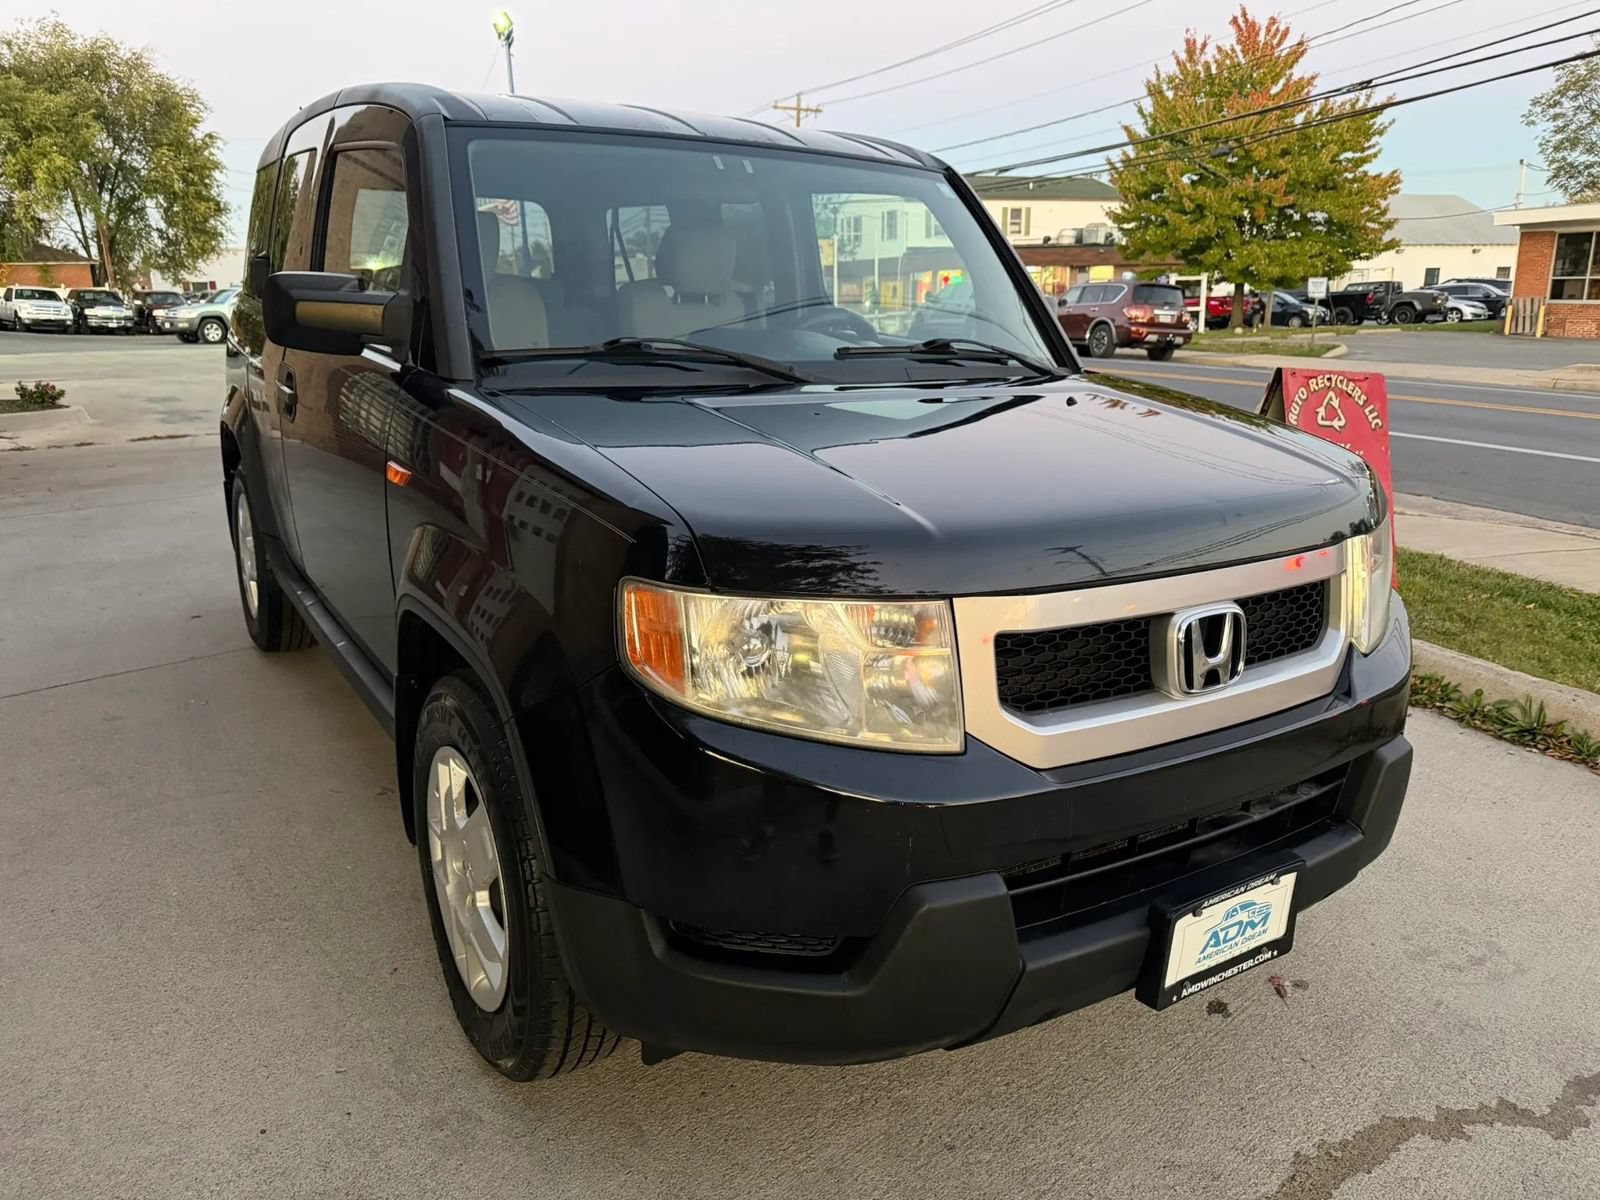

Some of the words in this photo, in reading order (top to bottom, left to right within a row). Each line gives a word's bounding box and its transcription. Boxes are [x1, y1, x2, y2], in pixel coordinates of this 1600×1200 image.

[1288, 387, 1308, 425] AUTO
[1308, 374, 1367, 406] RECYCLERS
[1364, 404, 1383, 430] LLC
[1201, 885, 1247, 908] AMERICAN
[1247, 873, 1277, 890] DREAM
[1195, 939, 1241, 965] AMERICAN
[1241, 928, 1268, 945] DREAM
[1199, 912, 1271, 955] ADM
[1181, 950, 1272, 998] AMDWINCHESTER.COM
